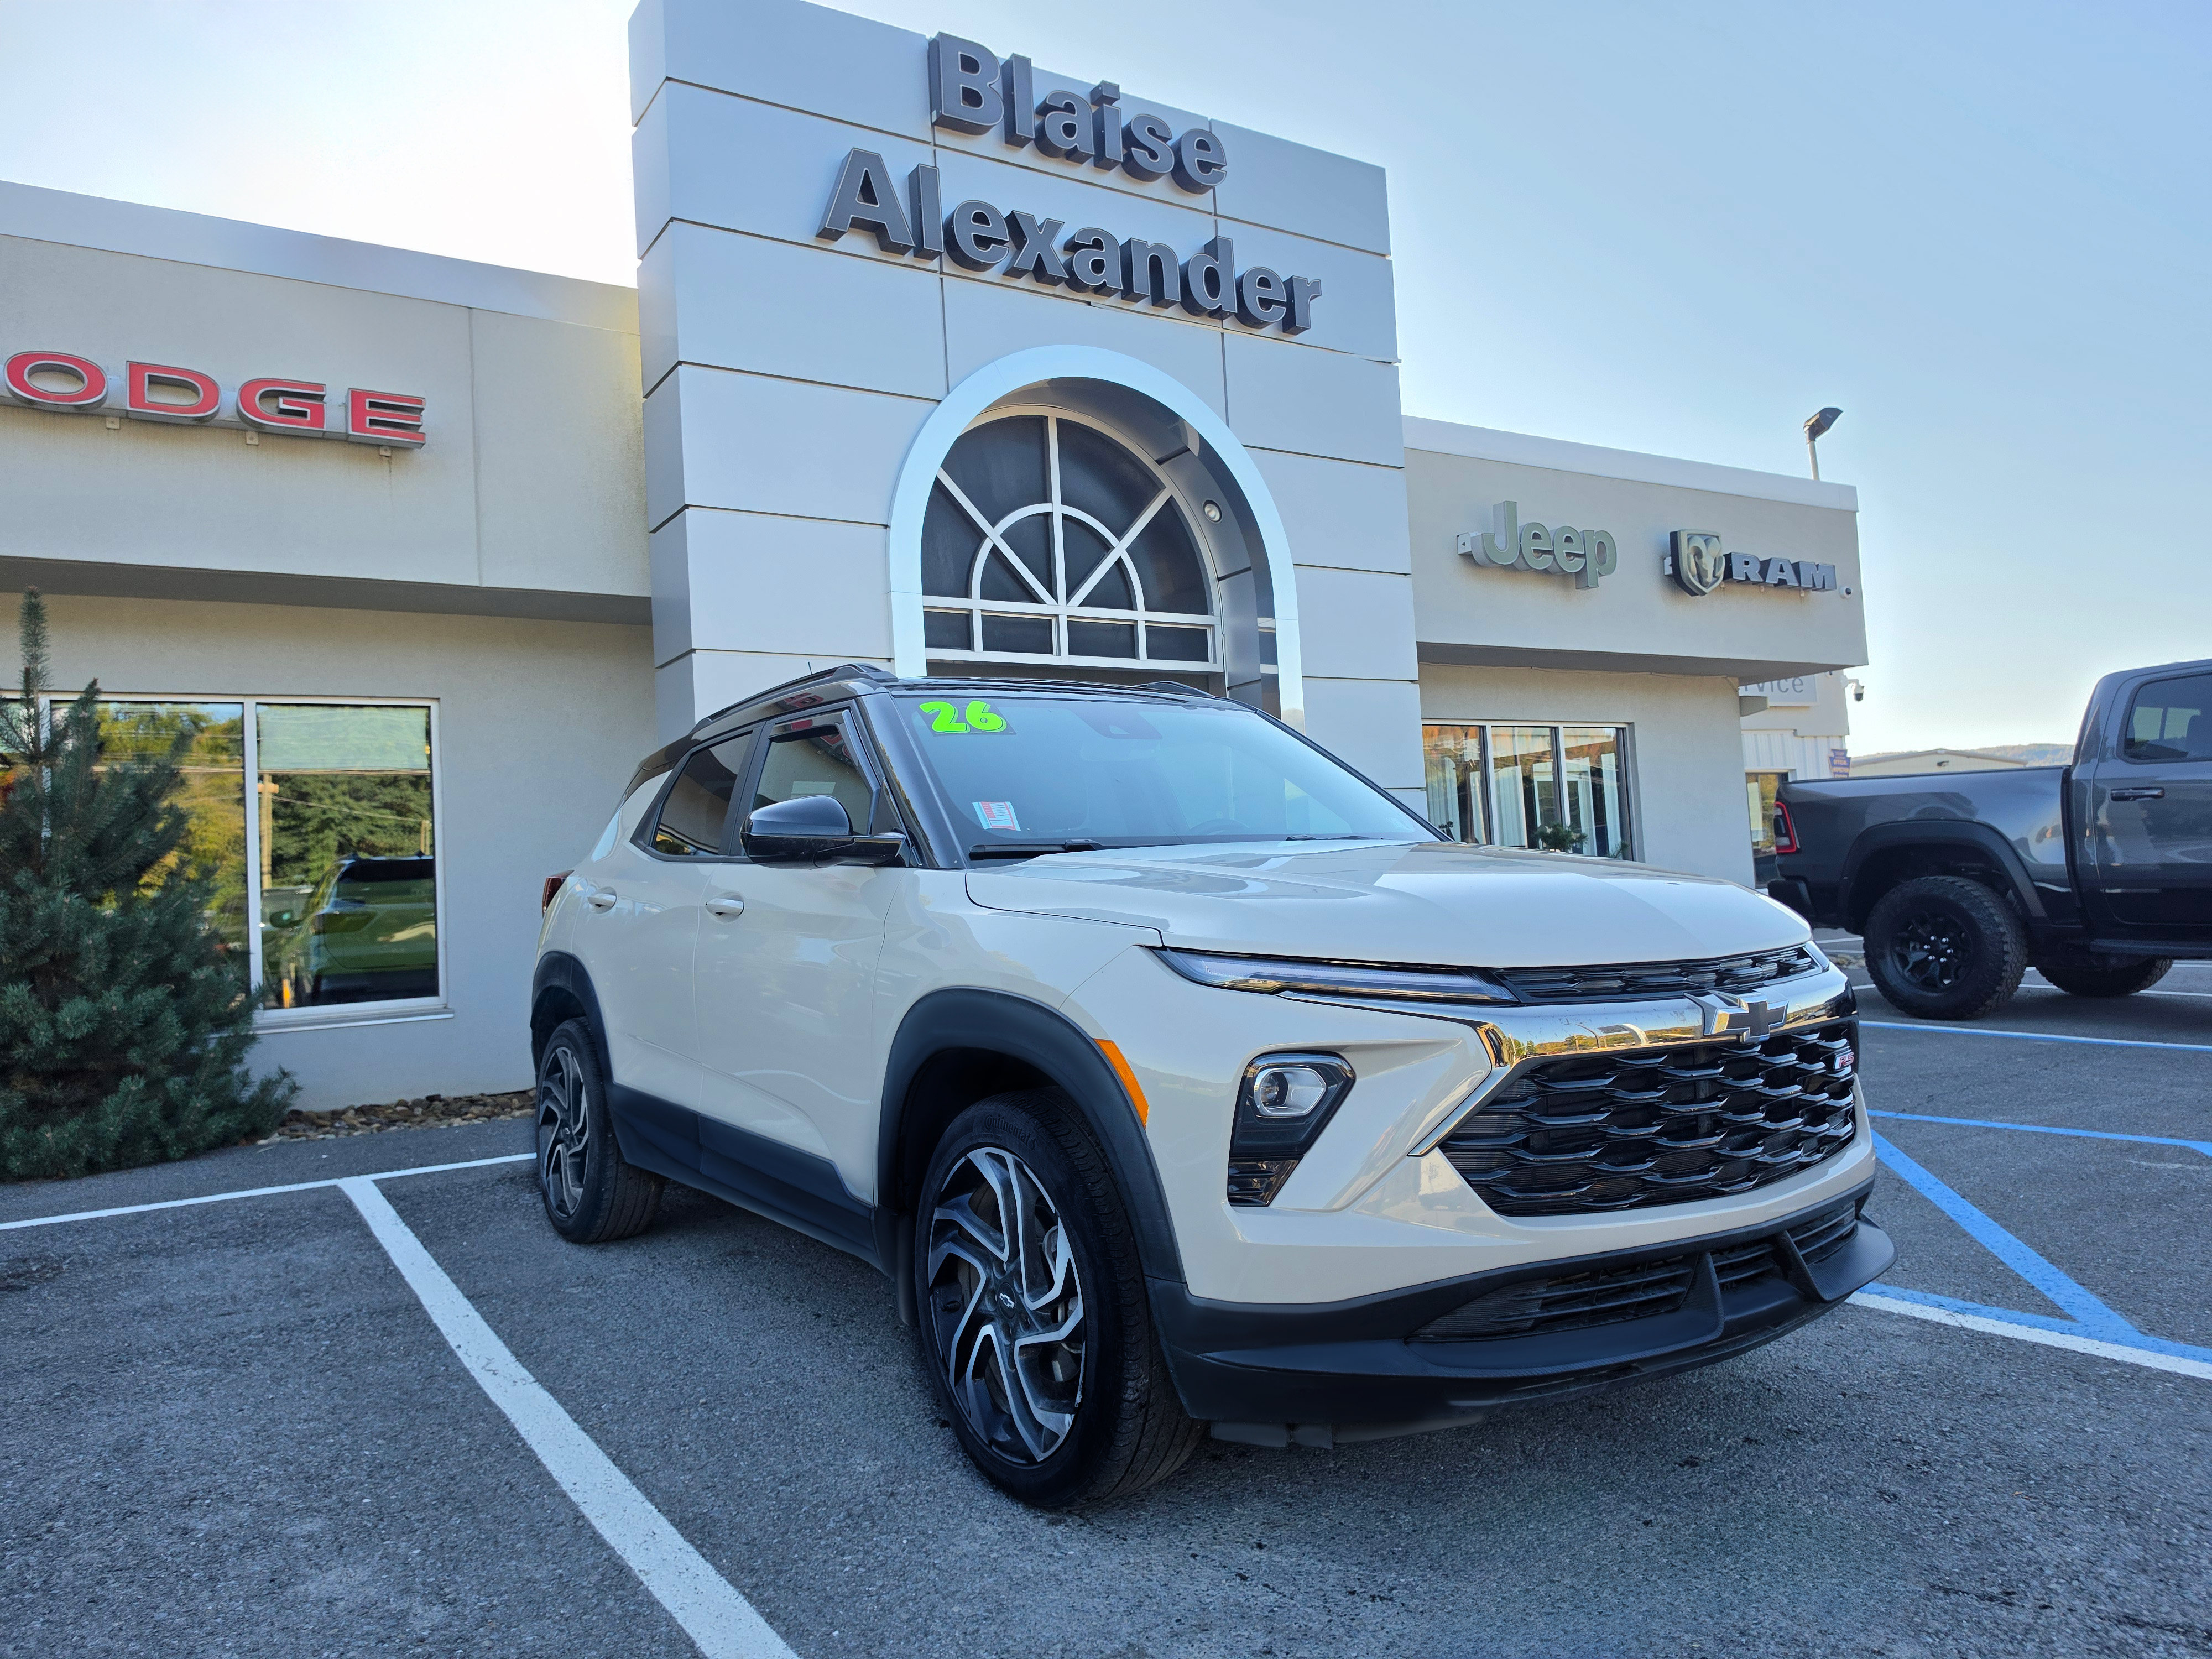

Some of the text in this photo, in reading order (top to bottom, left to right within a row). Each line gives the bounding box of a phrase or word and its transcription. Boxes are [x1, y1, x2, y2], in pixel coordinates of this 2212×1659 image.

[928, 32, 1227, 195] Blaise
[816, 148, 1322, 335] Alexander
[1471, 501, 1617, 590] Jeep
[1724, 552, 1837, 592] RAM
[919, 700, 1007, 733] 26
[1838, 1052, 1854, 1068] RS
